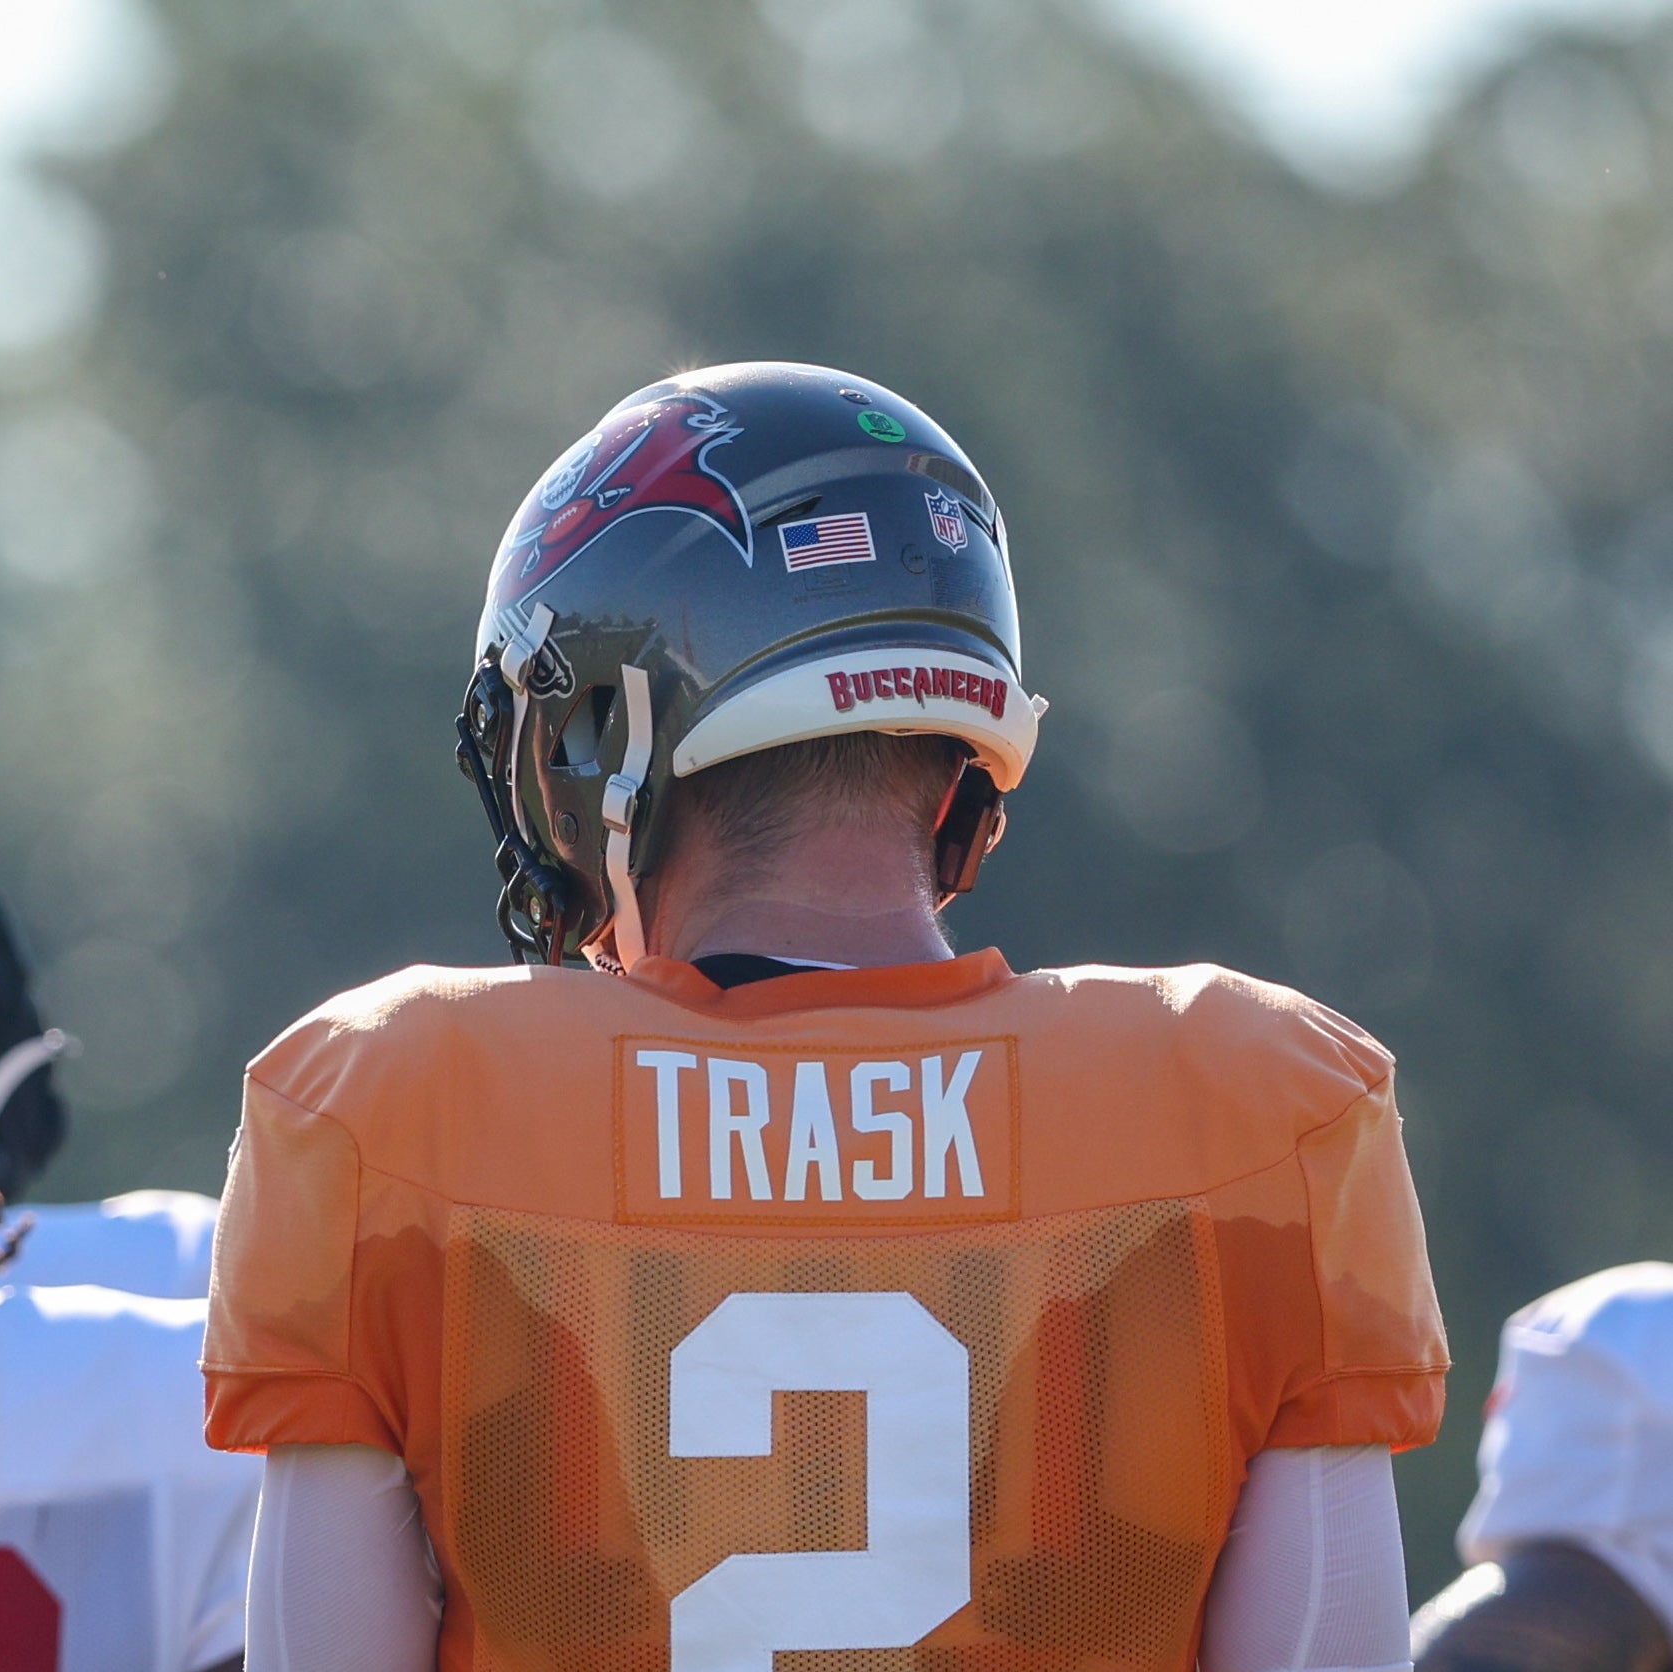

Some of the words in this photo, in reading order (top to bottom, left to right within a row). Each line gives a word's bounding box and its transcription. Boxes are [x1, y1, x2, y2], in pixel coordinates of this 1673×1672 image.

[936, 515, 964, 542] NFL
[824, 666, 1008, 721] BUCCANEERS
[636, 1049, 985, 1201] TRASK
